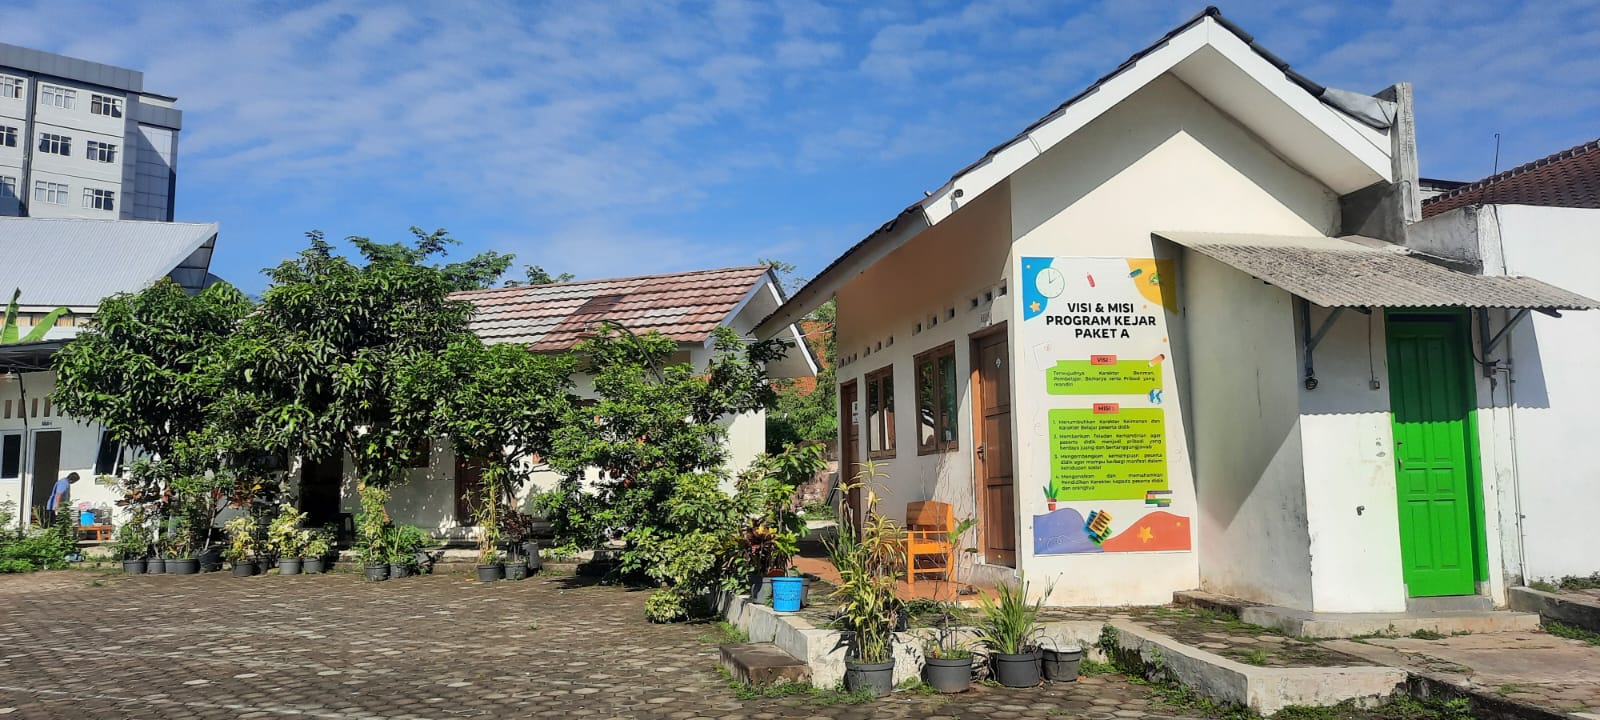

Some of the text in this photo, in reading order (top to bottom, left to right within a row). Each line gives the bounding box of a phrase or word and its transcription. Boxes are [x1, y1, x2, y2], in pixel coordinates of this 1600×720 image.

[1067, 303, 1134, 313] VISI & MISI
[1046, 316, 1156, 325] PROGRAM KEJAR
[1075, 328, 1130, 338] PAKET A
